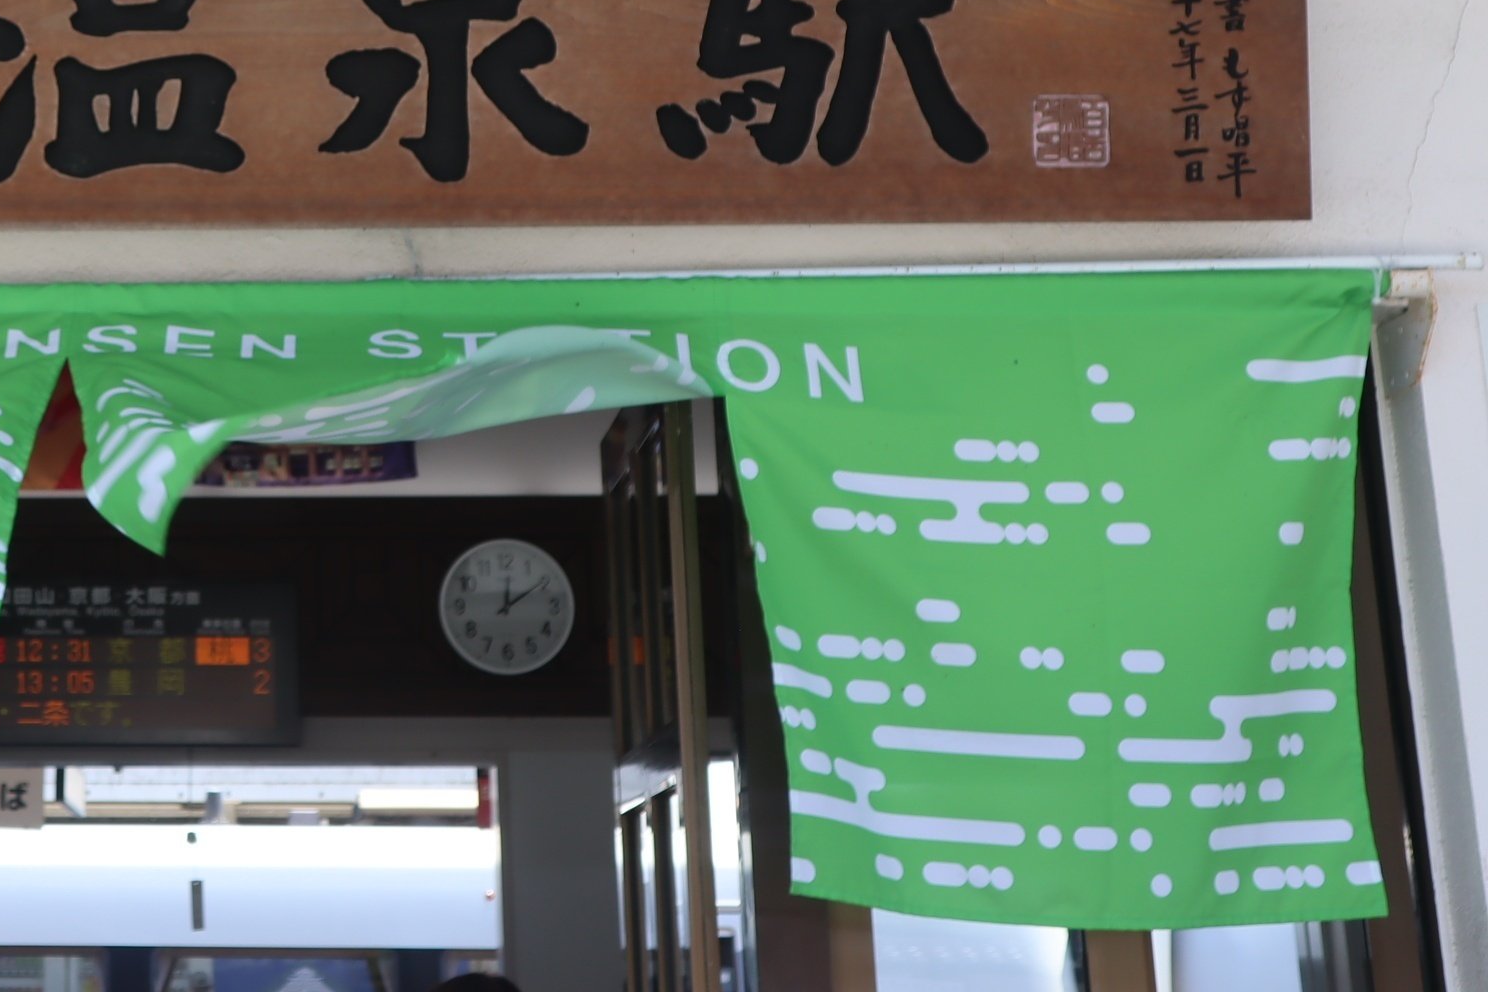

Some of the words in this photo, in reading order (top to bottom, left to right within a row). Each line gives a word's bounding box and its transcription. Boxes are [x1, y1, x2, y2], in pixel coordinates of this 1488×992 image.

[367, 328, 865, 403] STION
[477, 559, 491, 576] 11
[497, 553, 514, 570] 12
[524, 559, 532, 576] 1
[460, 575, 477, 593] 10
[455, 597, 466, 616] 9
[550, 597, 561, 616] 3
[466, 620, 478, 639] 8
[540, 620, 551, 637] 4
[16, 638, 92, 663] 12:31
[253, 638, 272, 663] 3
[482, 635, 493, 654] 7
[502, 643, 514, 661] 6
[525, 636, 537, 655] 5
[16, 670, 94, 695] 13:05
[254, 670, 271, 695] 2
